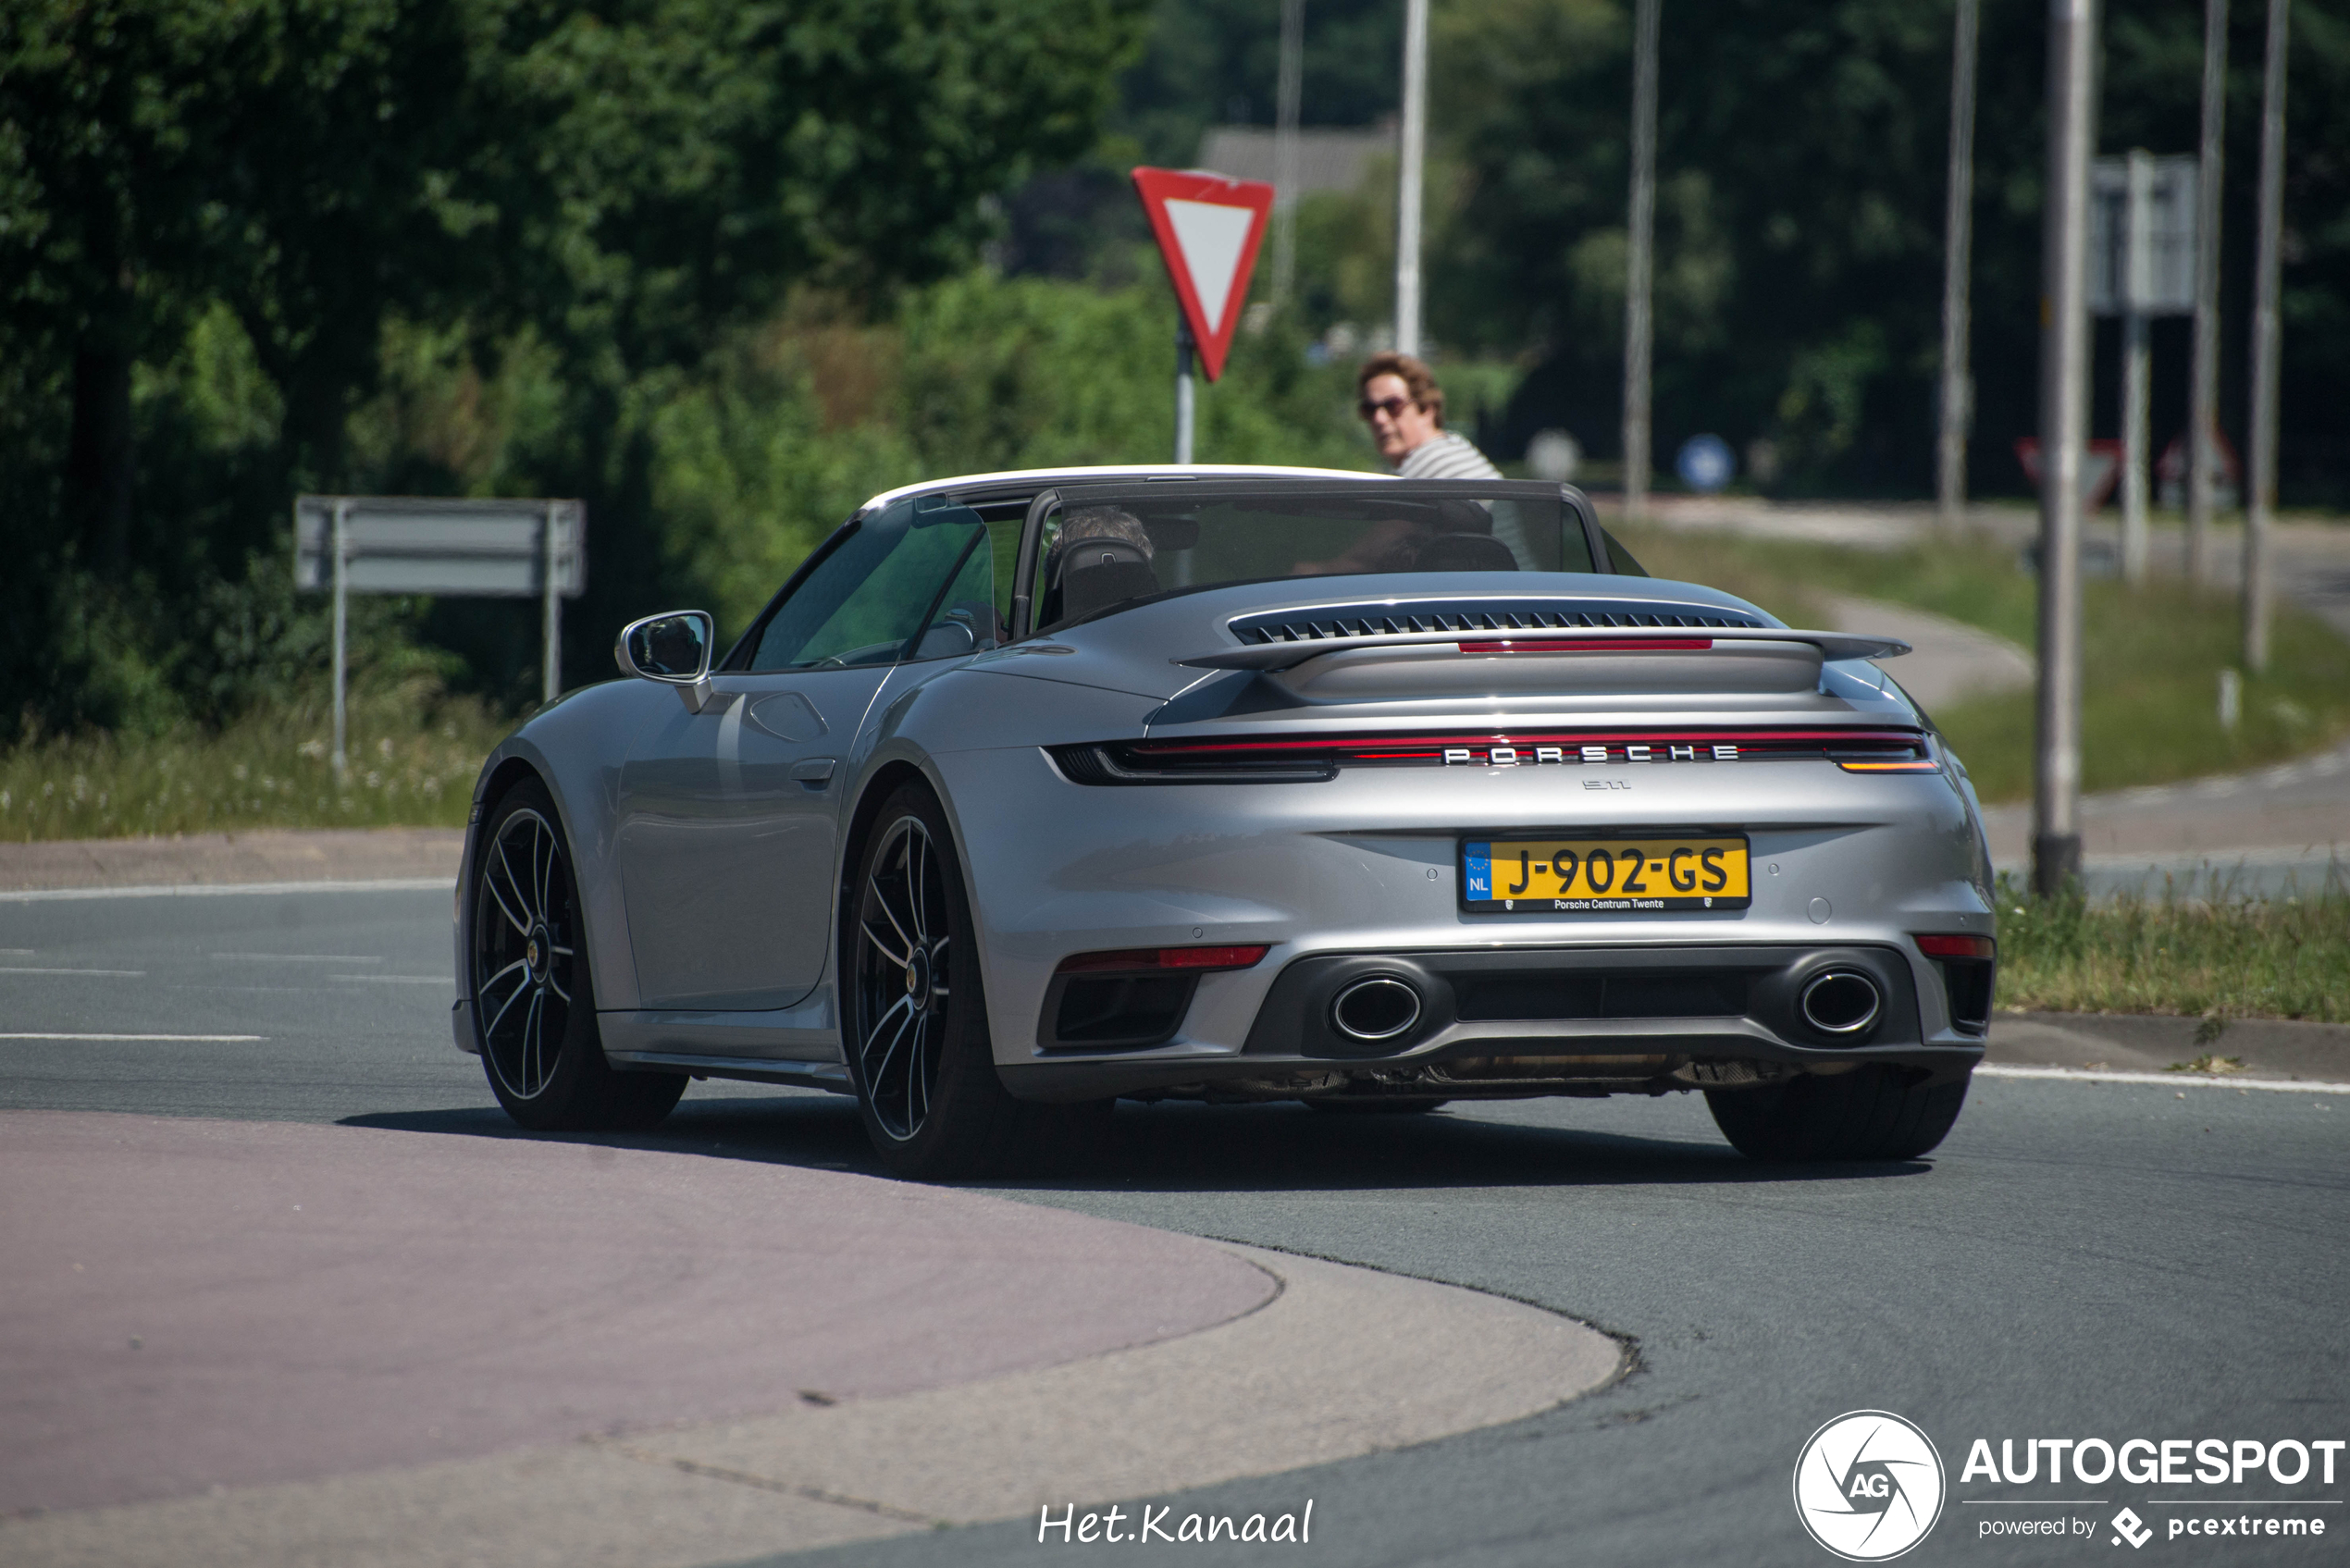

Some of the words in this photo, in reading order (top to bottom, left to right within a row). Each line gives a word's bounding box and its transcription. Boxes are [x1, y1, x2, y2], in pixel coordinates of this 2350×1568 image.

[1442, 745, 1739, 765] PORSCHE
[1582, 778, 1632, 791] 911
[1508, 847, 1728, 894] J-902-GS
[1469, 878, 1489, 891] NL
[1554, 899, 1589, 909] Porsche
[1591, 898, 1630, 909] Centrum
[1631, 898, 1664, 908] Twente
